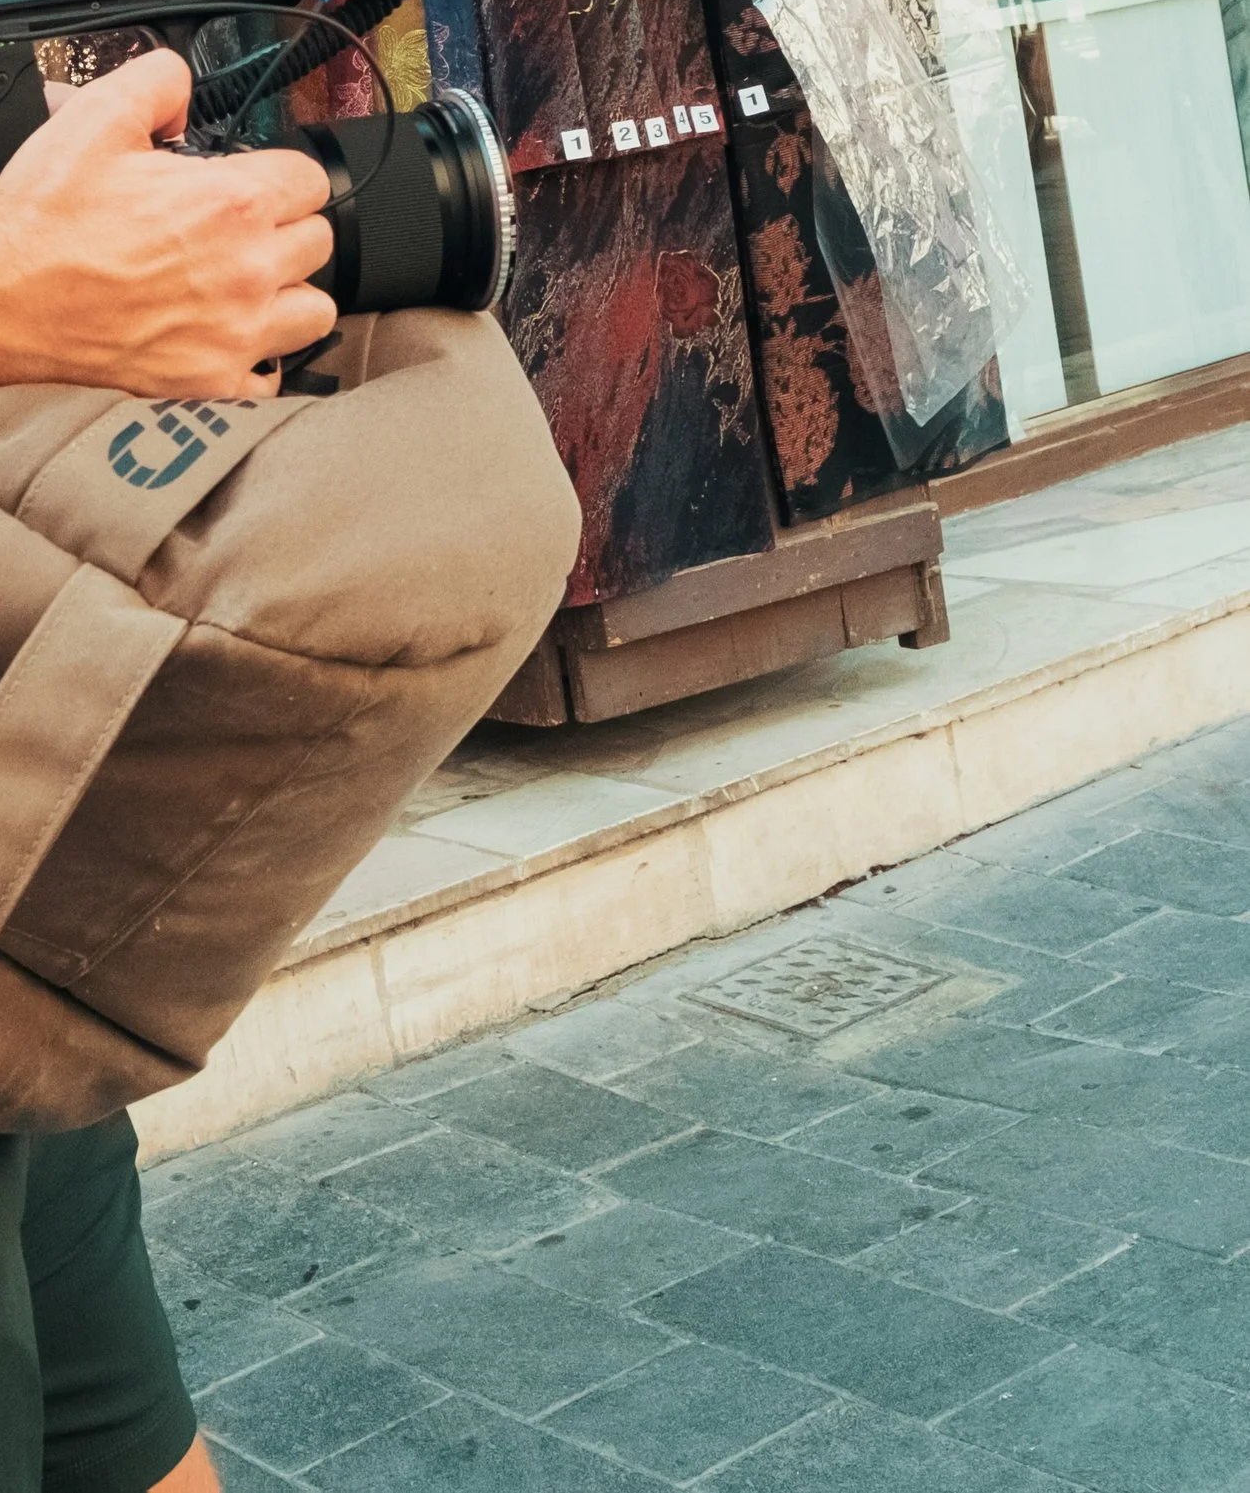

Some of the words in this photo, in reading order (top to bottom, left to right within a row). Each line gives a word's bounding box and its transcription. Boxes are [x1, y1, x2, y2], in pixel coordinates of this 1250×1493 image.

[745, 93, 758, 106] 1
[570, 136, 582, 151] 1
[619, 126, 632, 142] 2
[653, 123, 664, 139] 3
[678, 112, 686, 126] 4
[700, 111, 712, 125] 5
